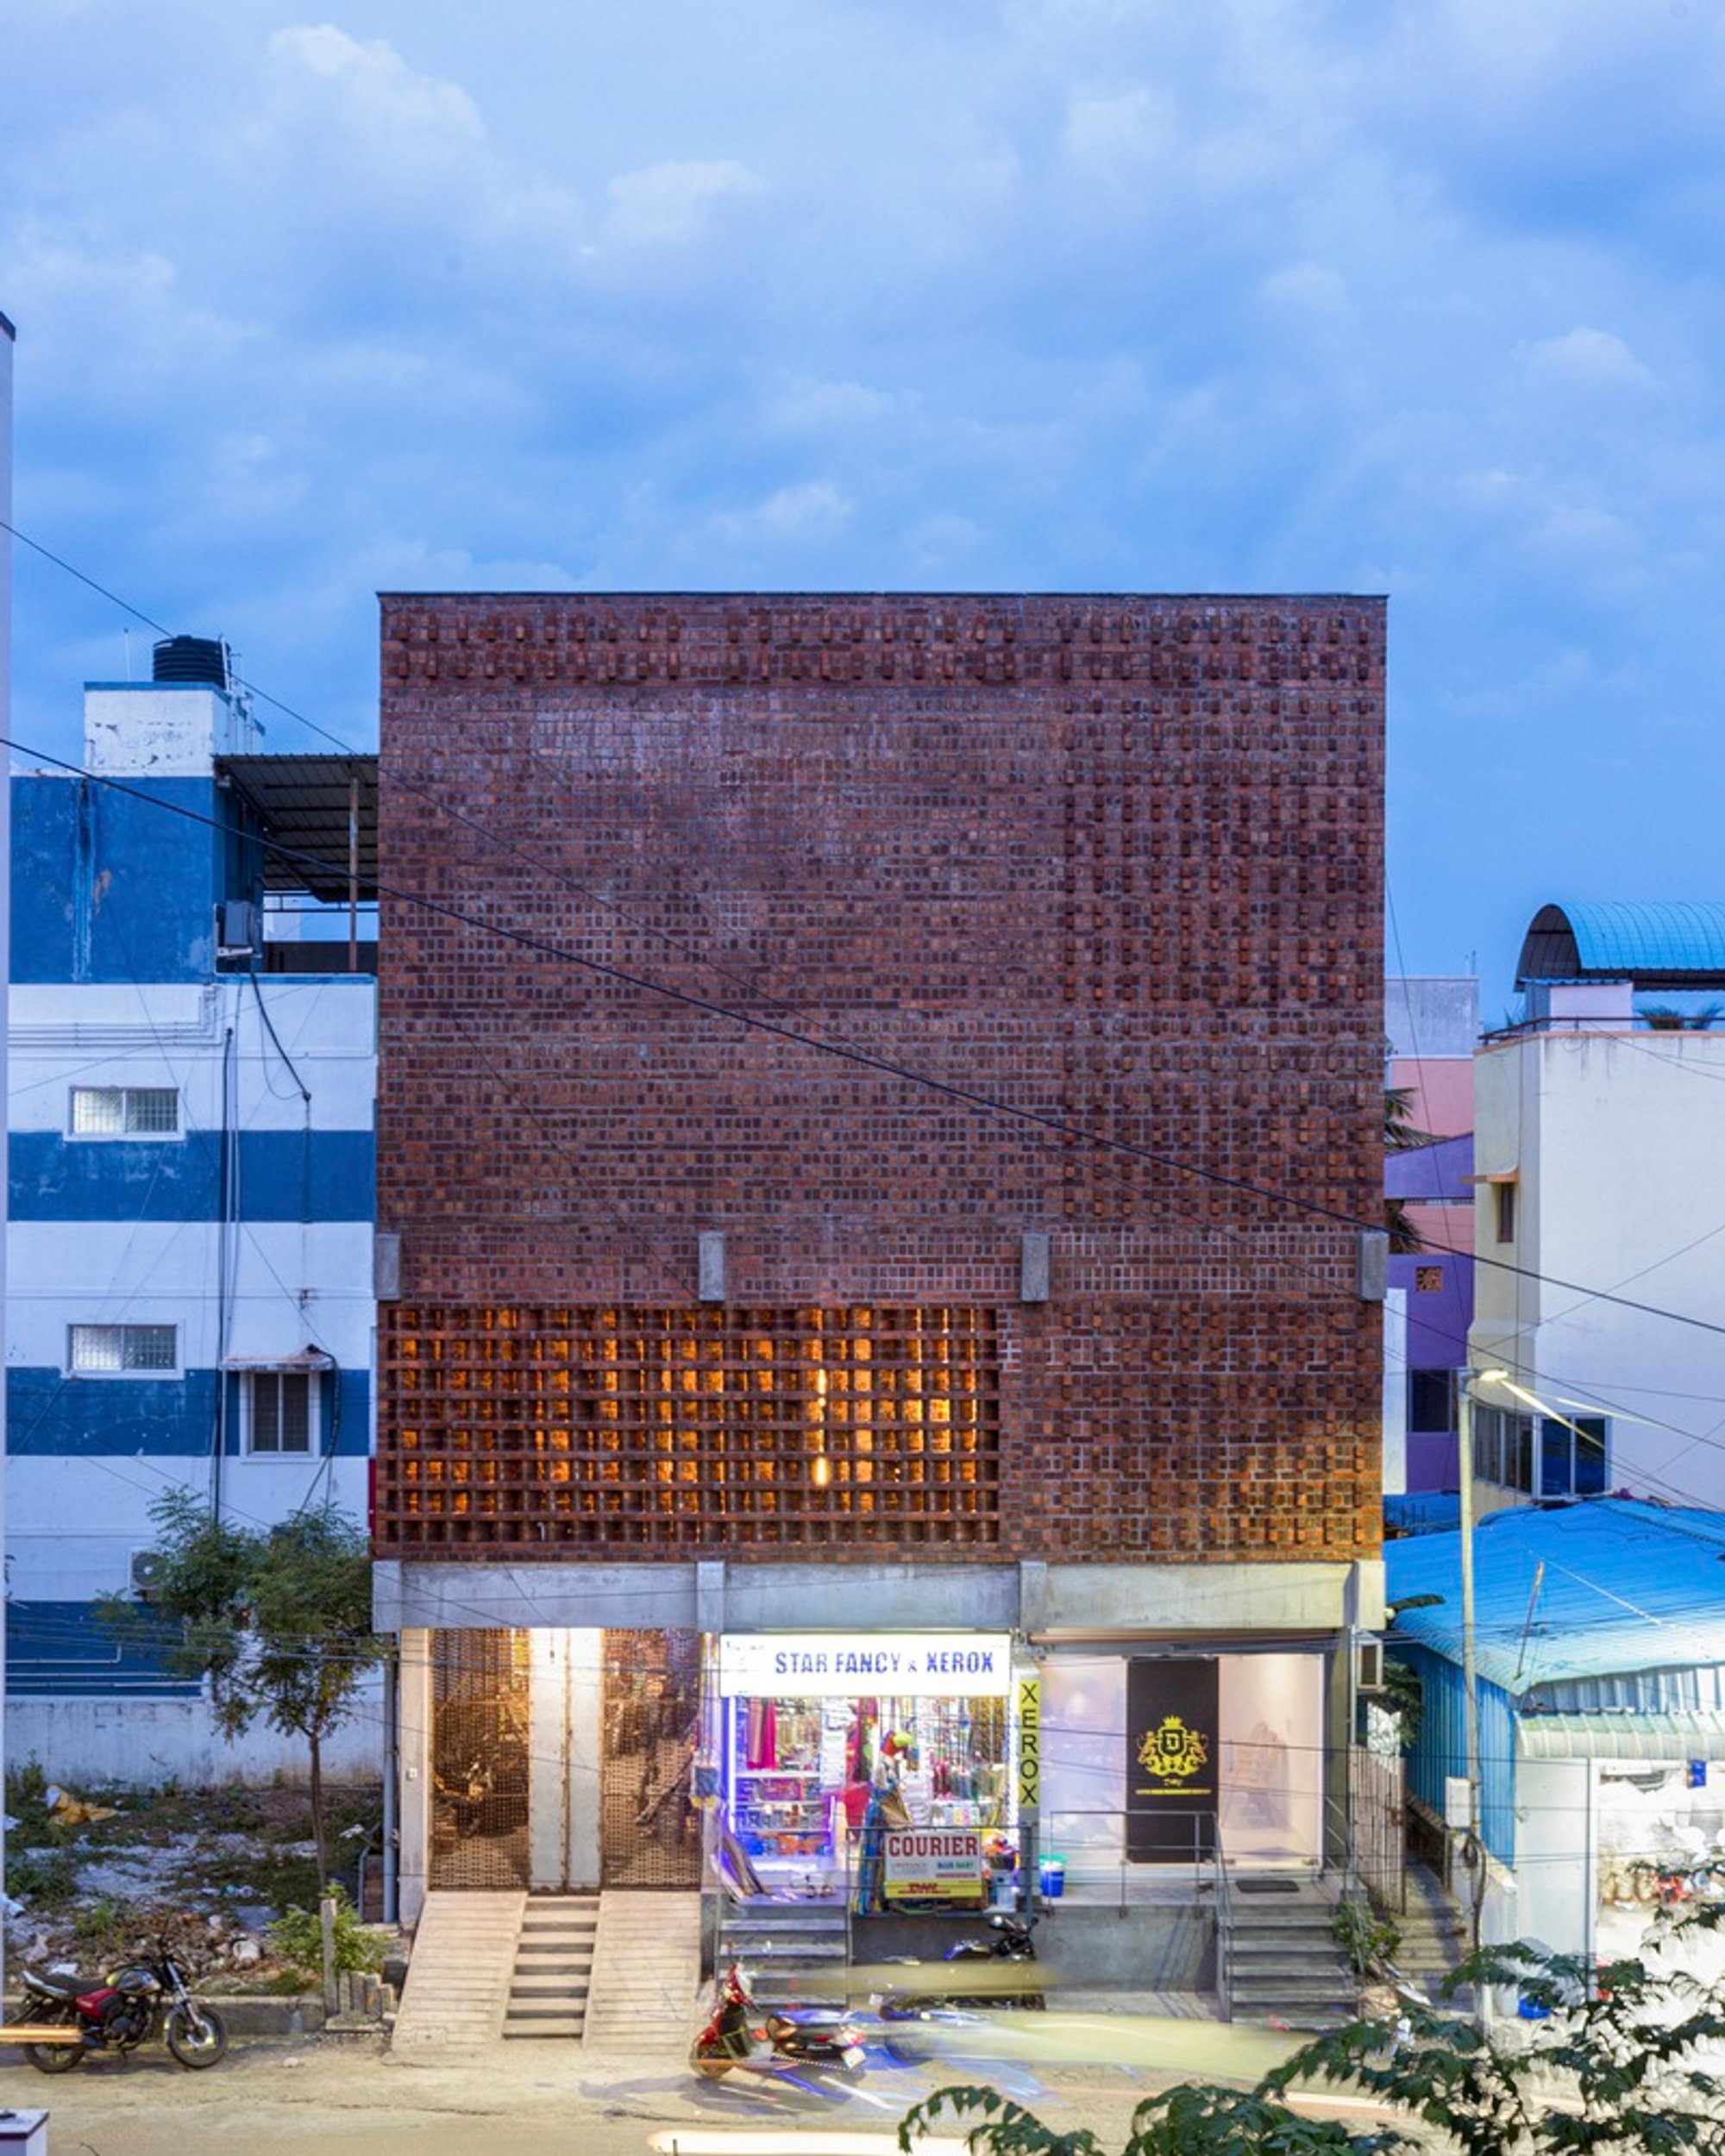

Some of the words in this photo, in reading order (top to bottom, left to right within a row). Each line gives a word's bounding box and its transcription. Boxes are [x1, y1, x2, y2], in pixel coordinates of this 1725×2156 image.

[775, 1652, 827, 1673] STAR
[836, 1652, 900, 1673] FANCY
[926, 1651, 993, 1673] XEROX
[1020, 1683, 1038, 1803] XEROX
[888, 1836, 977, 1858] COURIER
